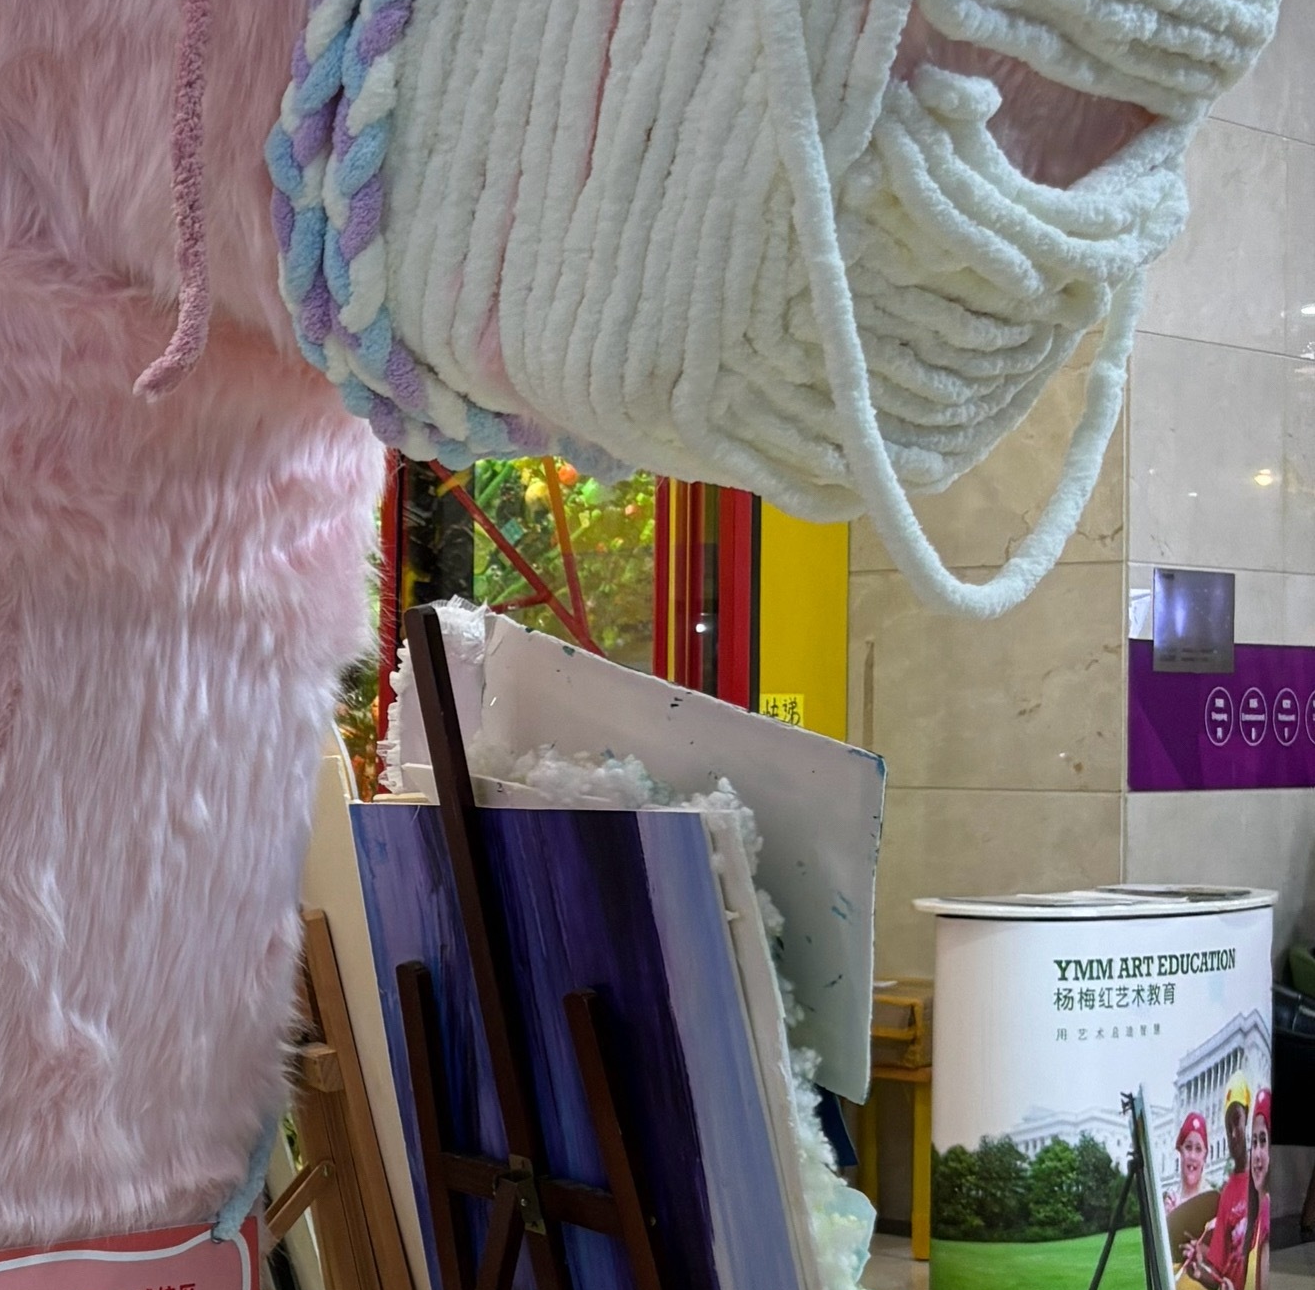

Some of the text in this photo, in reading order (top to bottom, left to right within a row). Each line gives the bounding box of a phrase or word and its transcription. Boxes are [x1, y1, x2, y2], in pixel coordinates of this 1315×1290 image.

[1054, 948, 1236, 981] YMM ART EDUCATION
[1053, 982, 1177, 1011] 杨梅红艺术教育
